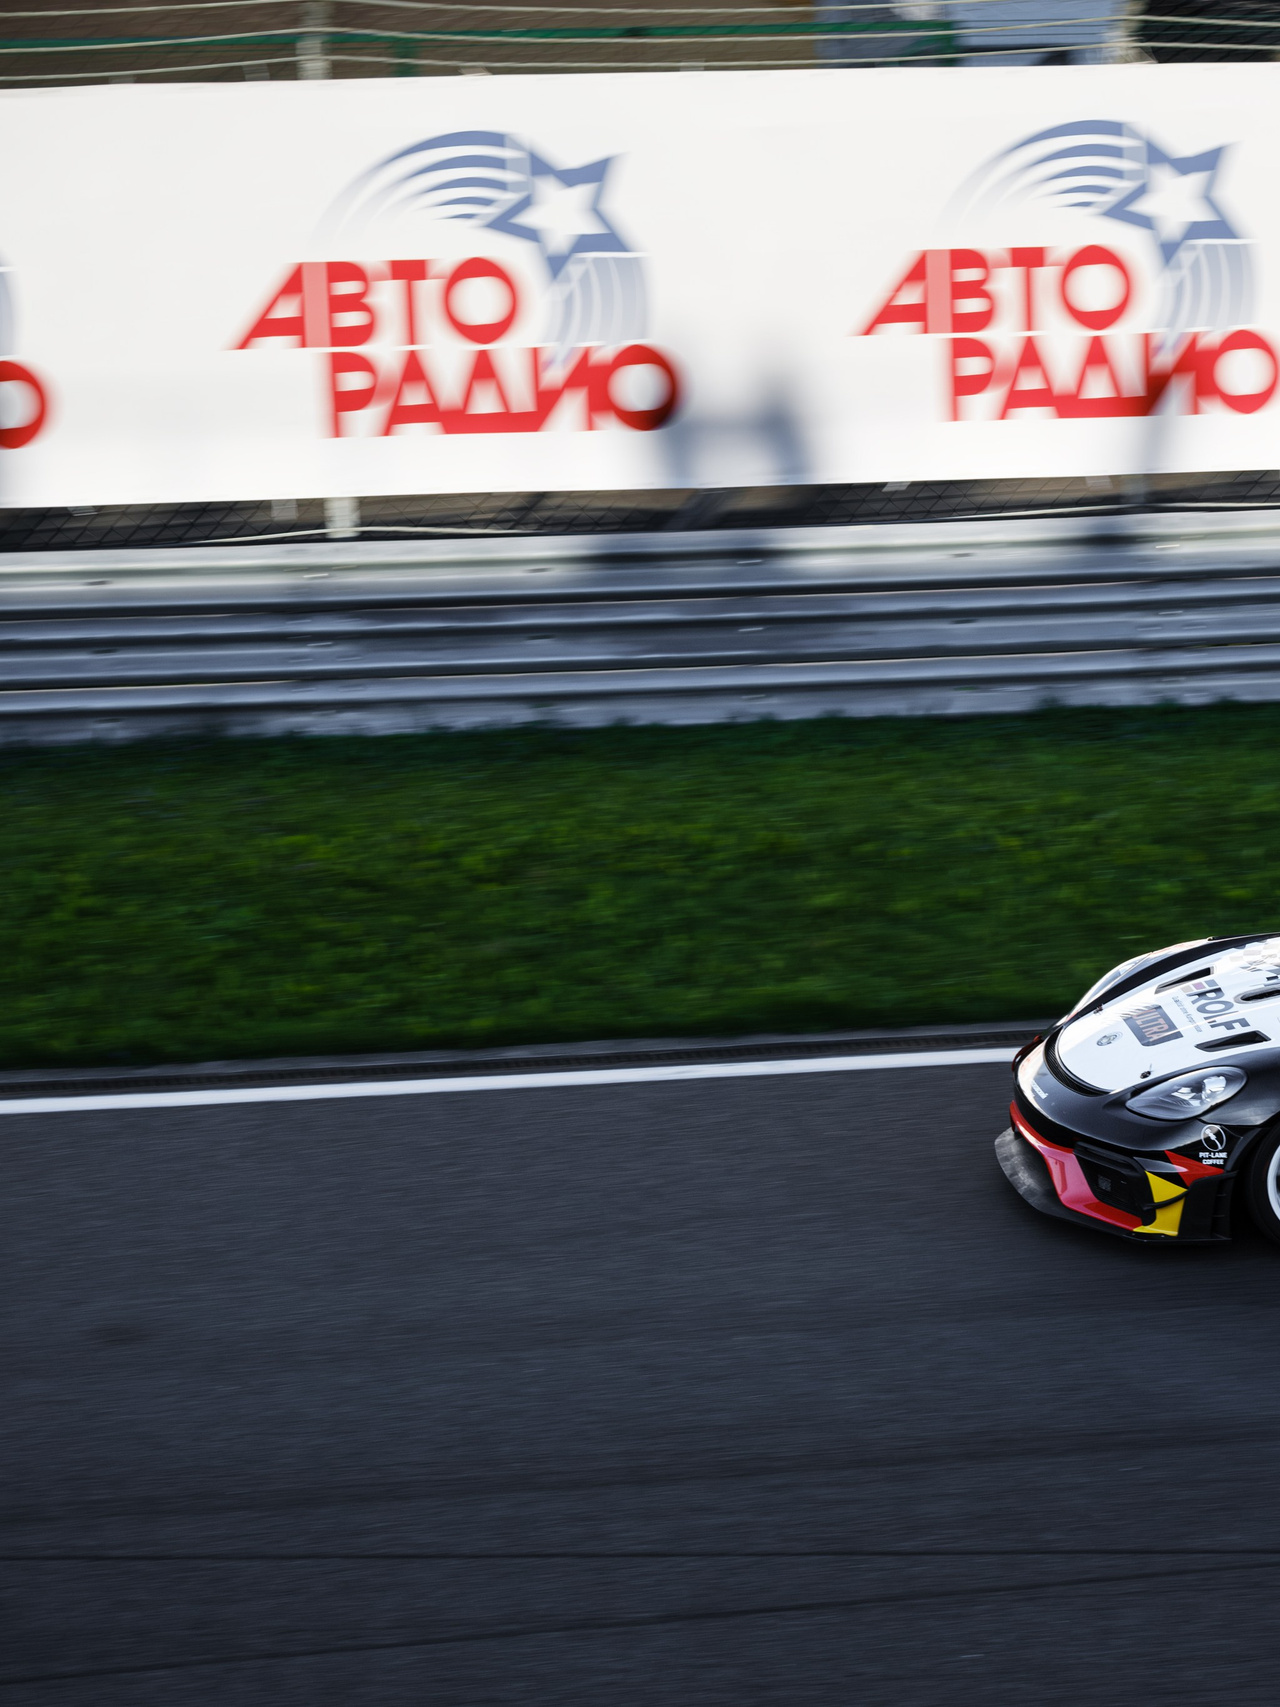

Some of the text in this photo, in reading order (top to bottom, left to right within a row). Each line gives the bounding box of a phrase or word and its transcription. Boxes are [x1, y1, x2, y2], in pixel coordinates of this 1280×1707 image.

[226, 257, 524, 350] АВТО
[850, 244, 1134, 336] АВТО
[324, 343, 684, 438] РАДИО
[1132, 1008, 1170, 1042] ULTRA
[1186, 987, 1251, 1031] ROLF
